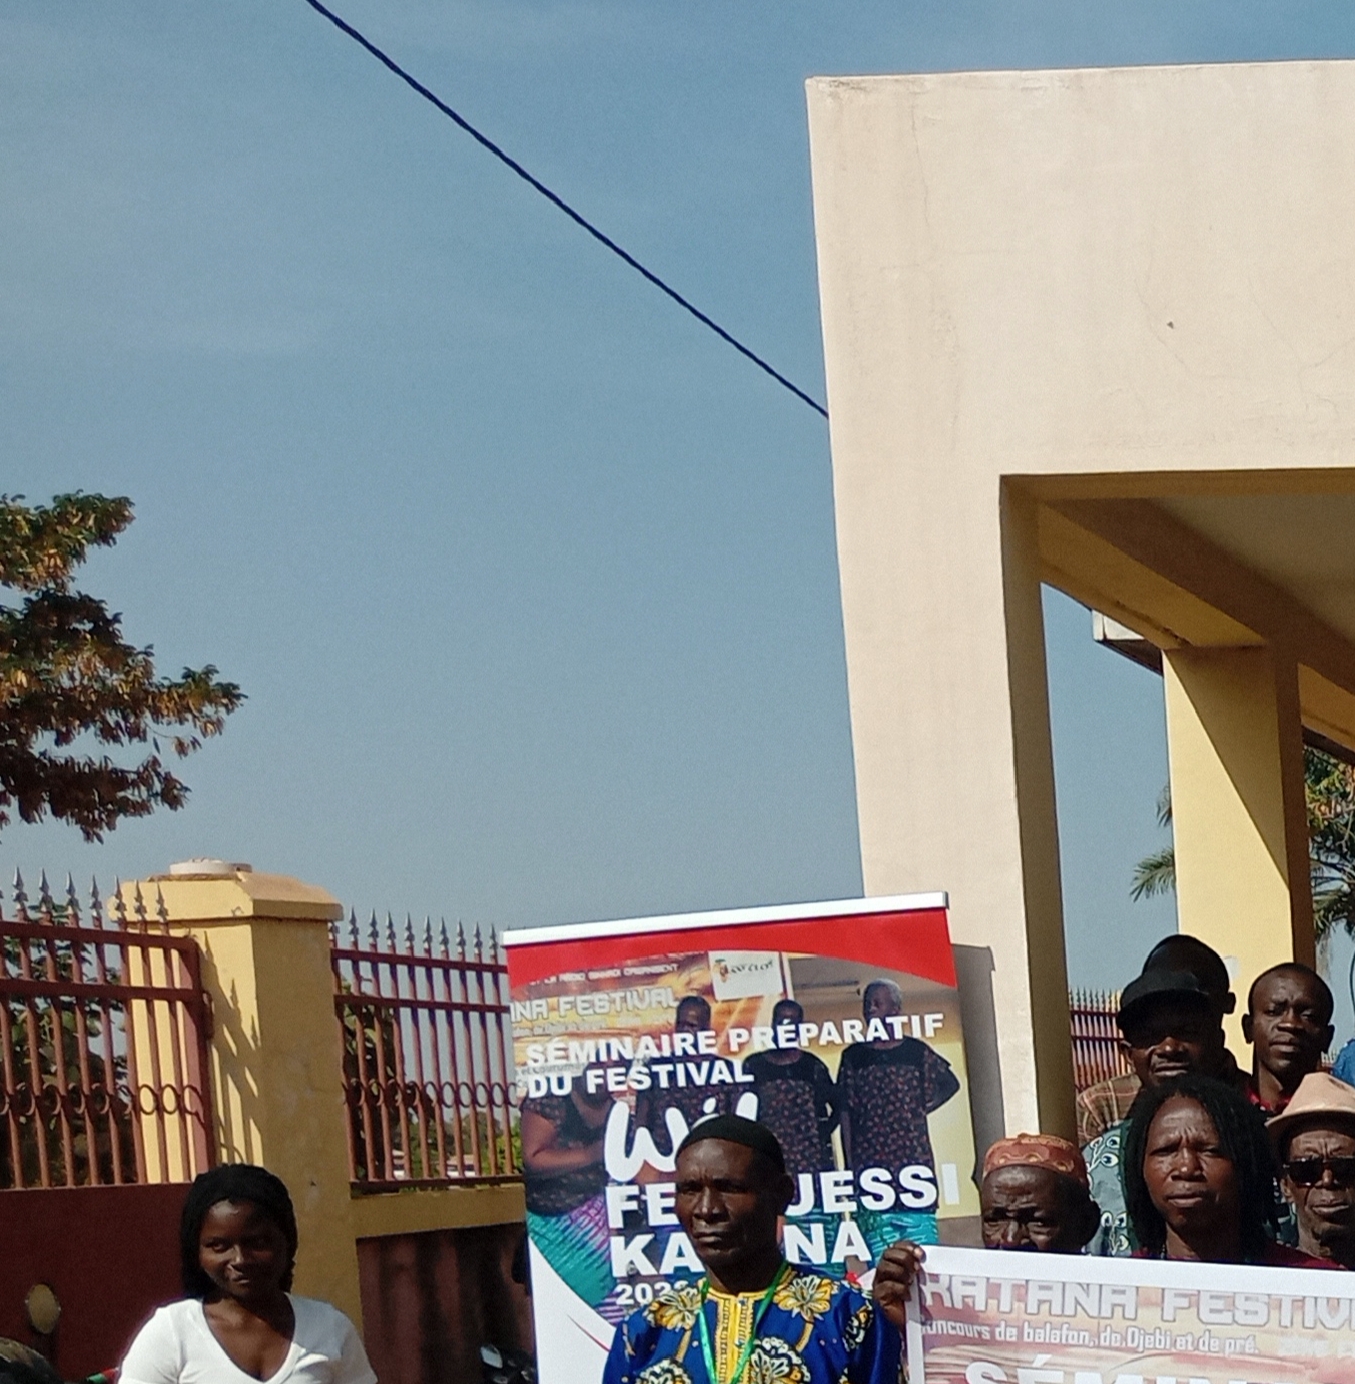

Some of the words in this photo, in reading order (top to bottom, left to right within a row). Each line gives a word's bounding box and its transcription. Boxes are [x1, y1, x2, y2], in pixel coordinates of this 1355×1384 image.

[558, 986, 679, 1018] FESTIVAL
[526, 1030, 718, 1066] SÉMINAIRE
[728, 1013, 945, 1053] PRÉPARATIF
[528, 1071, 572, 1098] DU
[586, 1058, 754, 1094] FESTIVAL
[922, 1272, 1137, 1321] KATANA
[1199, 1329, 1220, 1352] de
